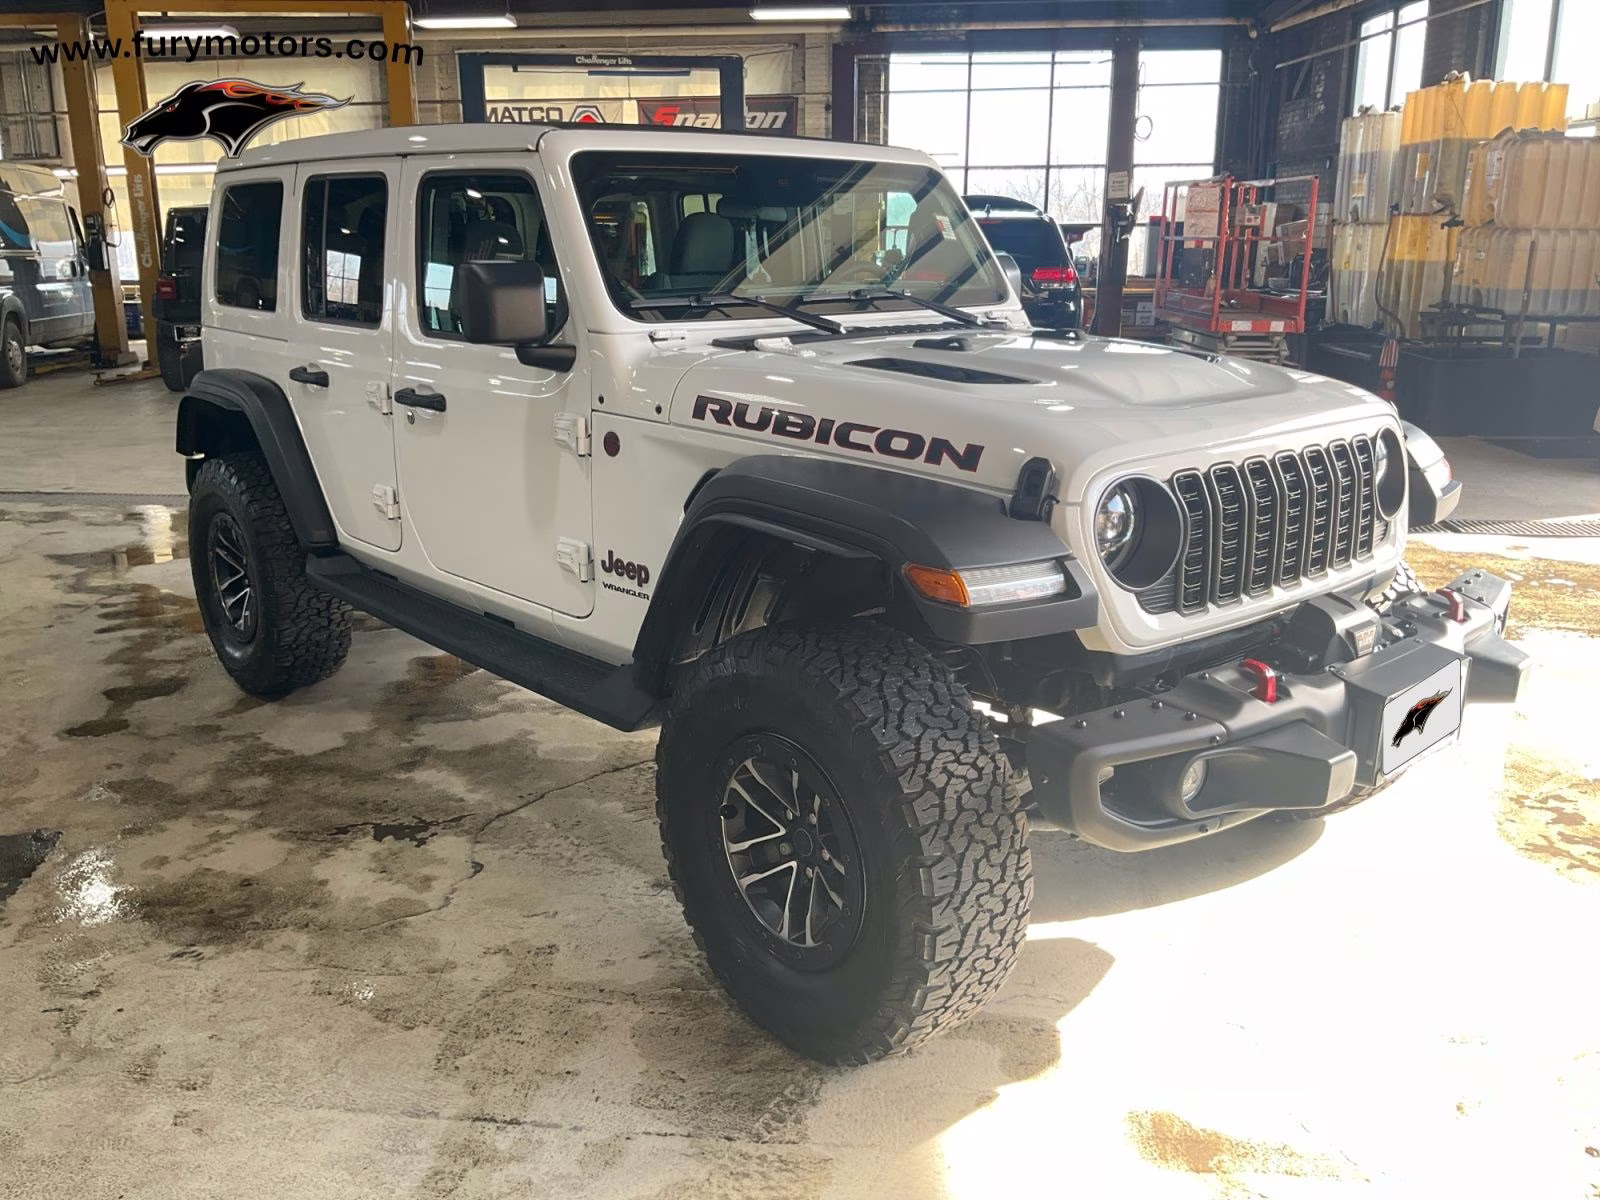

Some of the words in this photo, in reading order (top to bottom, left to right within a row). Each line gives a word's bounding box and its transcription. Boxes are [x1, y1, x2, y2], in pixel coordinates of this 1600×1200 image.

[575, 54, 617, 66] Challenger
[618, 57, 633, 65] Lifts
[487, 106, 563, 122] MATCO
[654, 105, 787, 129] Snaon
[132, 174, 145, 197] Lifts
[136, 200, 153, 268] Challenger
[692, 394, 985, 473] RUBICON
[601, 549, 650, 588] Jeep
[602, 581, 650, 601] WRANGLER
